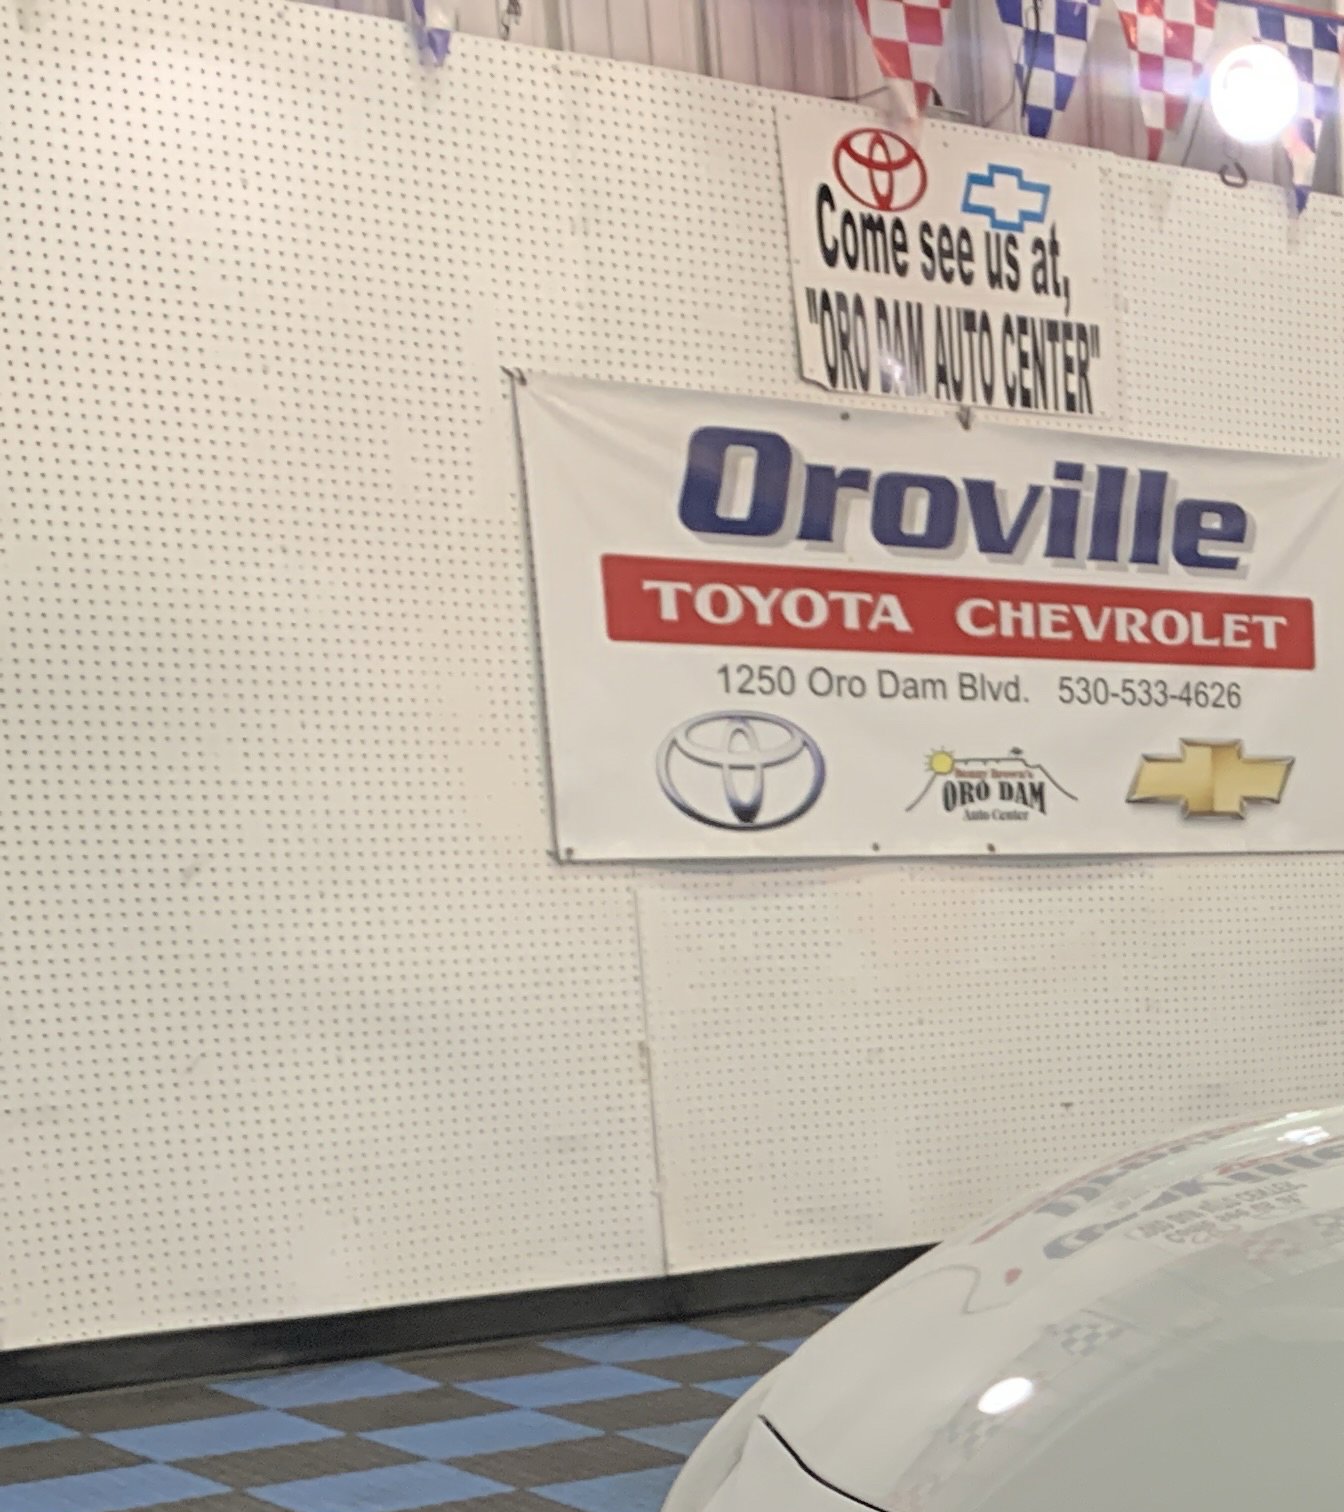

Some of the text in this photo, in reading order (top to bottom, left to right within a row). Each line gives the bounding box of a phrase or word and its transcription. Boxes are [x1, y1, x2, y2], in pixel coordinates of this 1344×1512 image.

[816, 183, 1070, 316] Come see us at,
[805, 287, 1101, 415] "ORO DAM AUTO CENTER"
[677, 425, 1249, 571] Oroville
[643, 579, 1289, 650] TOYOTA CHEVROLET
[716, 664, 1243, 709] 1250 Oro Dam Blvd. 530-533-4626
[943, 780, 1047, 815] ORO DAM
